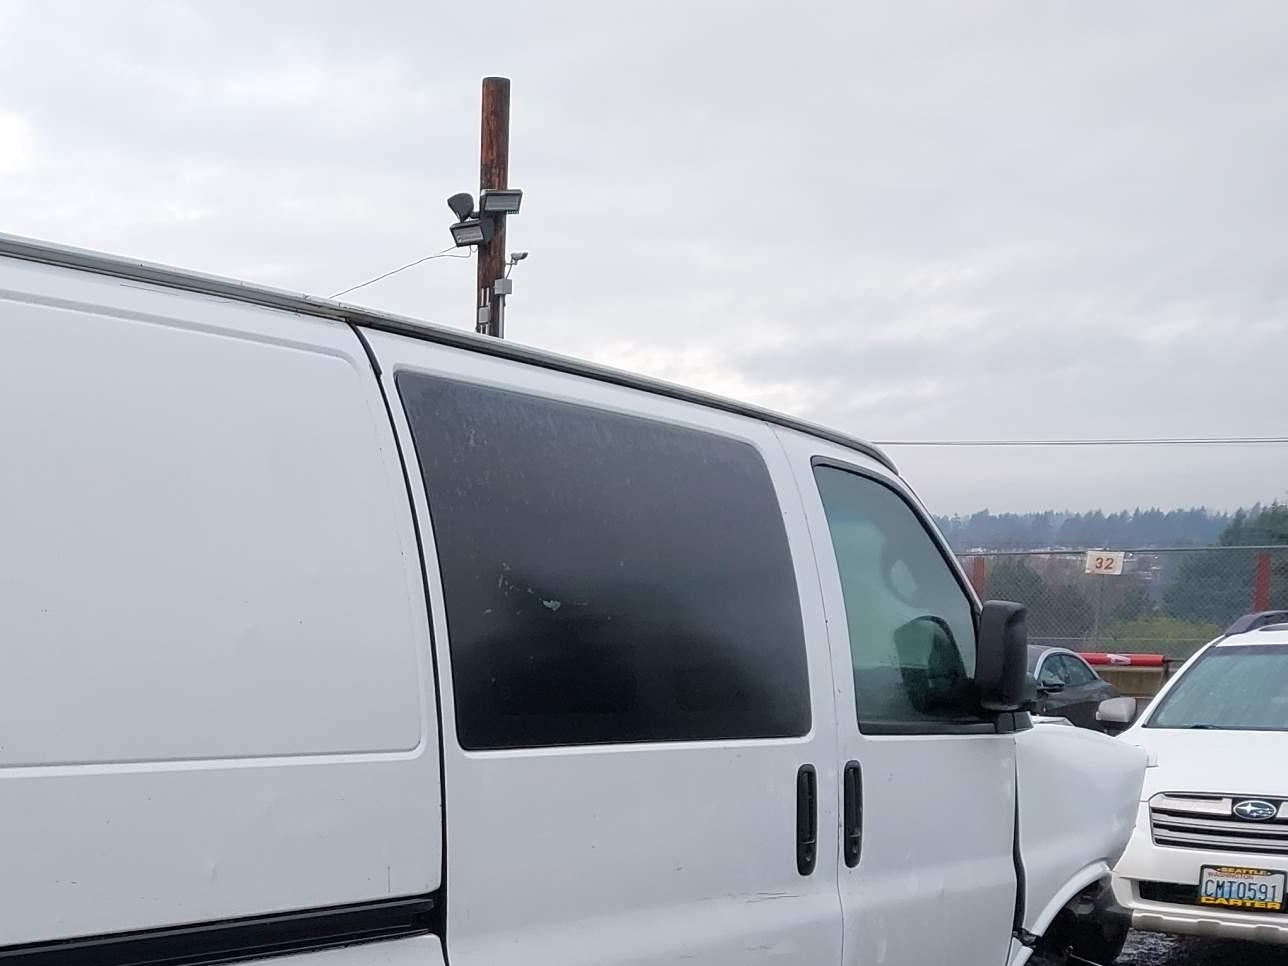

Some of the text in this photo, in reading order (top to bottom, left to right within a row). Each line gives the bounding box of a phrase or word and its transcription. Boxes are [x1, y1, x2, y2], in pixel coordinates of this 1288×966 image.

[1095, 557, 1114, 570] 32
[1221, 867, 1268, 876] SEATTLE
[1204, 879, 1277, 903] CMT0591
[1200, 896, 1281, 910] CARTER
